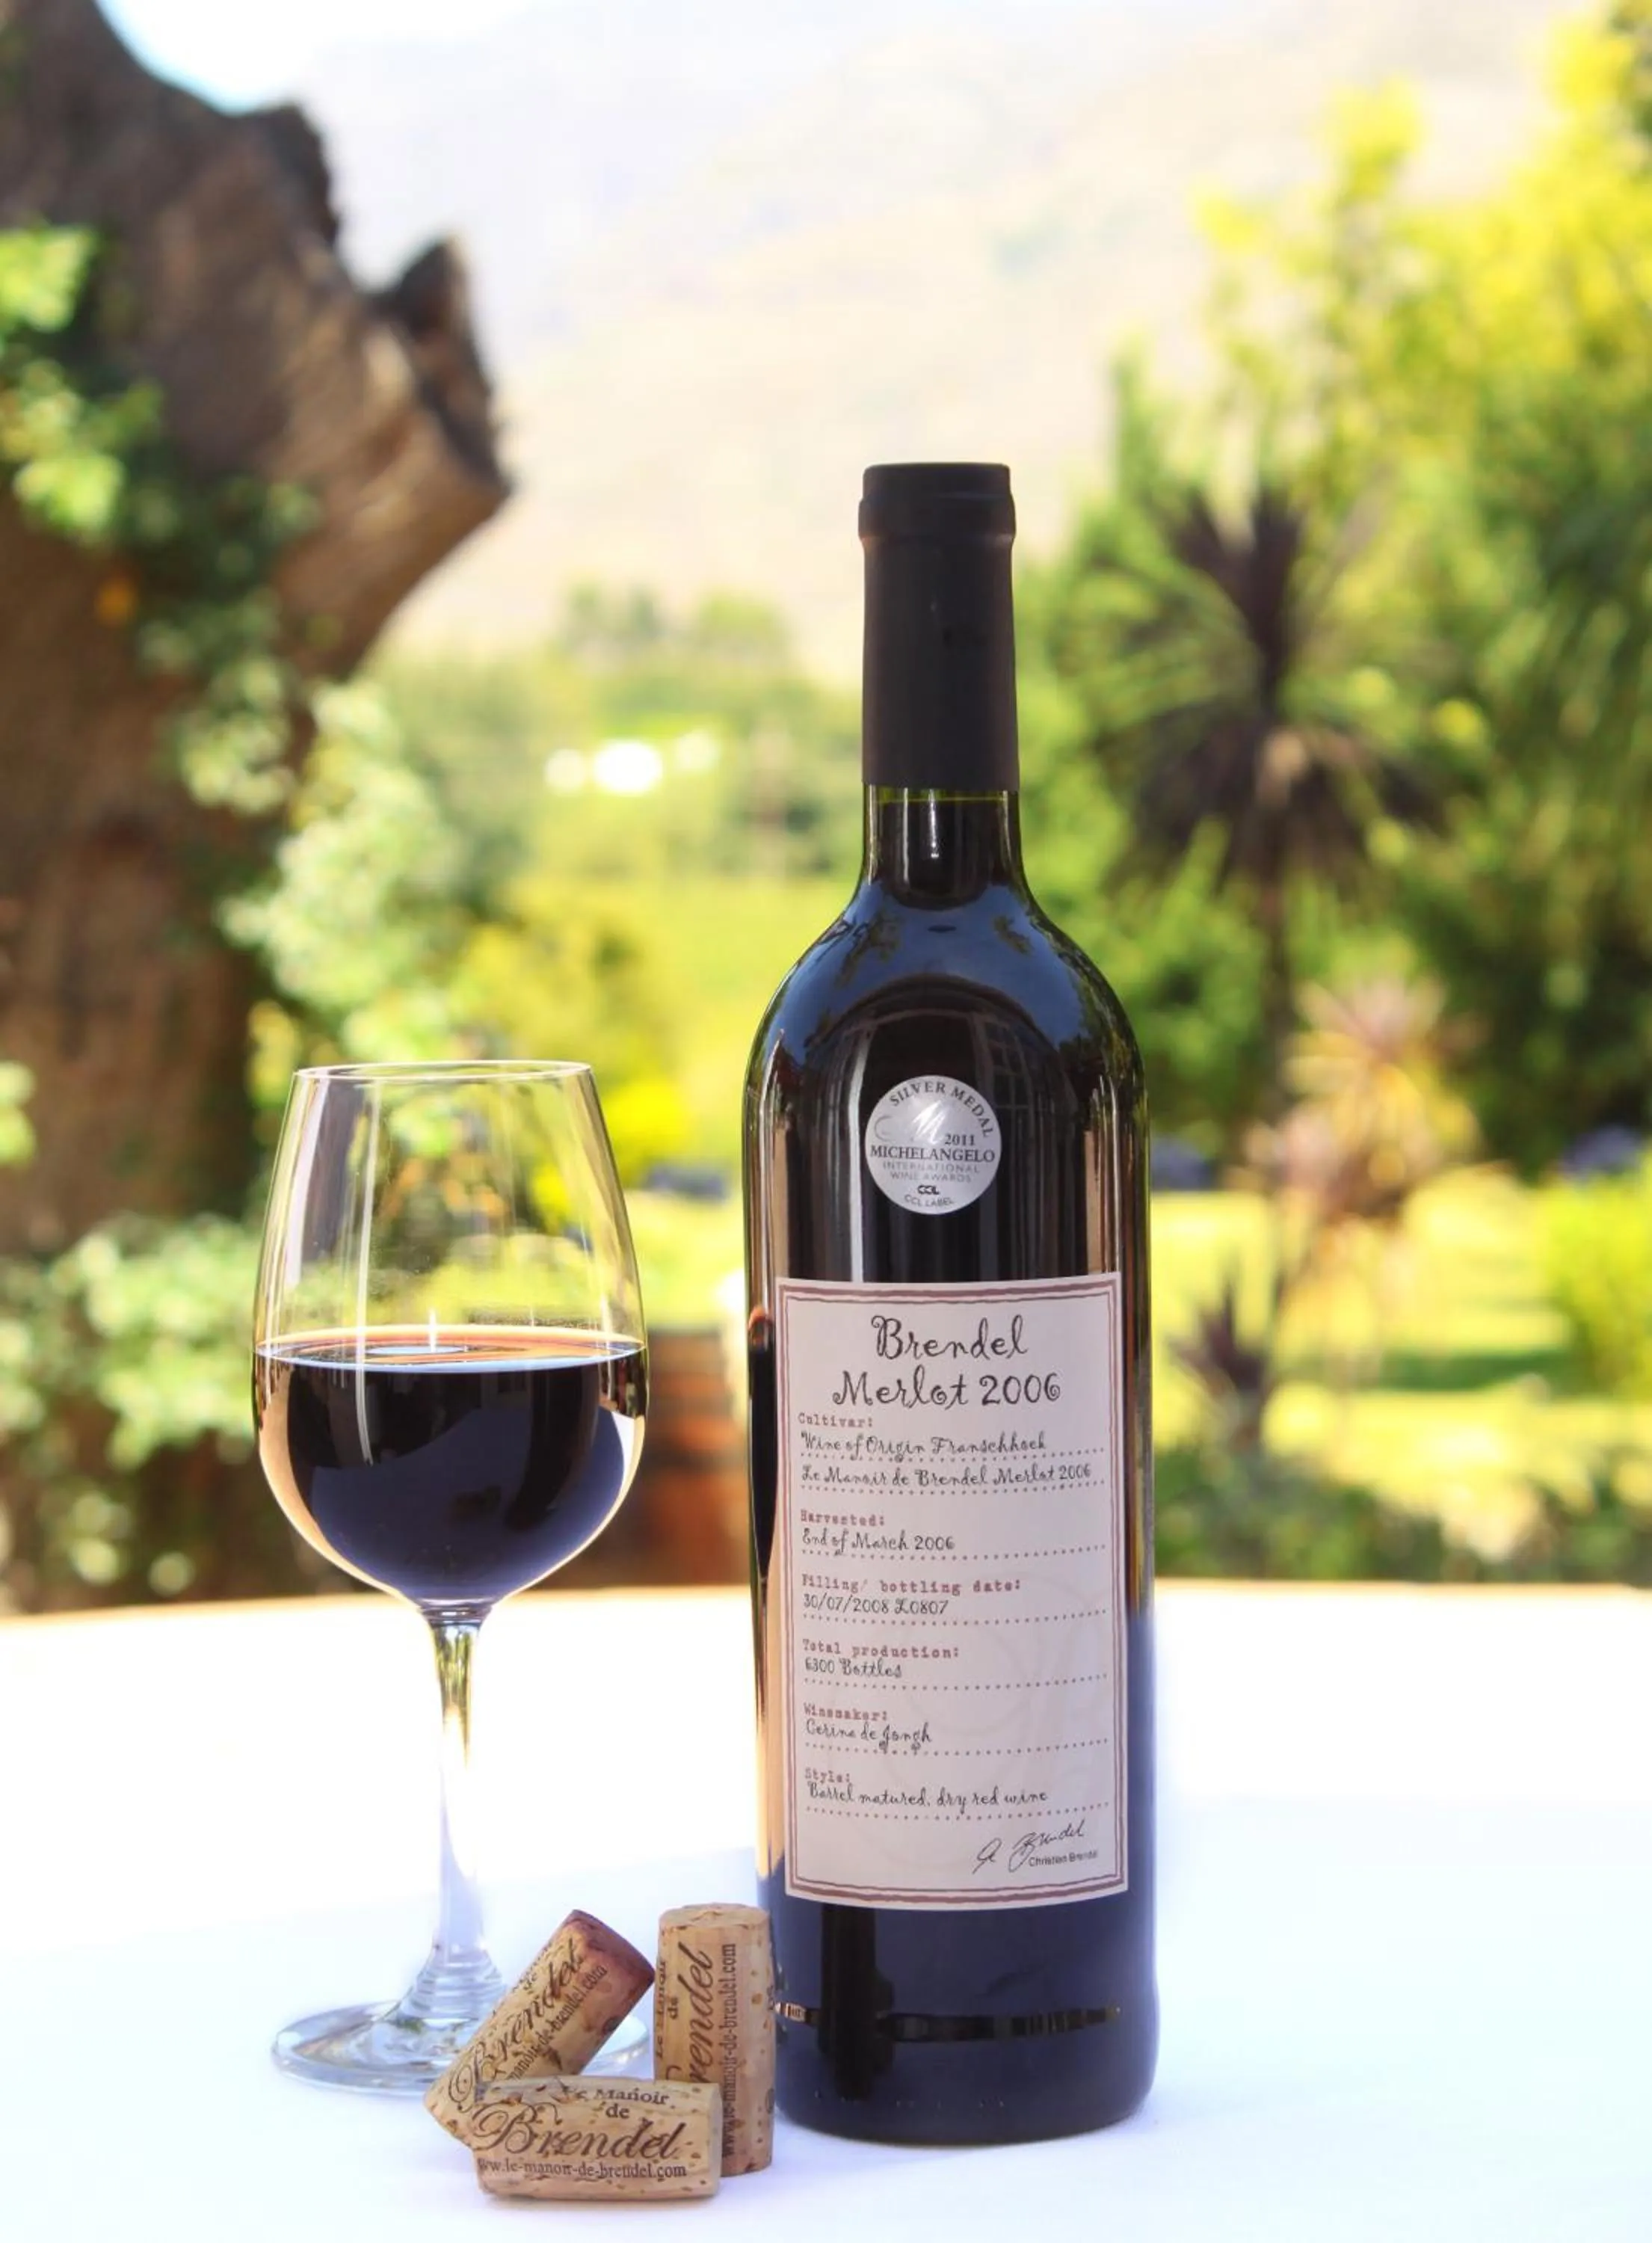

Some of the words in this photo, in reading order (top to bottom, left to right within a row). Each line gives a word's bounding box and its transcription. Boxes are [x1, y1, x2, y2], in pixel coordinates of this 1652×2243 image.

[890, 1081, 946, 1107] SILVER
[951, 1086, 993, 1139] MEDAL
[944, 1133, 976, 1145] 2011
[869, 1145, 996, 1163] MICHELANGELO
[882, 1160, 981, 1174] INTERNATIONAL
[890, 1171, 919, 1181] WINE
[922, 1173, 973, 1183] AWARDS
[904, 1194, 922, 1207] CCL
[925, 1197, 955, 1207] LABEL
[871, 1314, 1029, 1360] Brendel
[832, 1364, 970, 1409] Merlot
[978, 1372, 1062, 1406] 2006
[798, 1412, 874, 1427] Cultivar:
[801, 1430, 842, 1450] Wine
[845, 1433, 864, 1461] of
[866, 1435, 926, 1463] Origin
[801, 1463, 821, 1481] Le
[823, 1465, 887, 1486] Manoir
[892, 1466, 910, 1486] de
[913, 1464, 987, 1487] Brendel
[992, 1462, 1055, 1485] Merlot
[1058, 1462, 1091, 1480] 2006
[801, 1509, 885, 1526] Harvested:
[801, 1527, 827, 1545] End
[830, 1527, 850, 1556] of
[851, 1530, 910, 1551] March
[913, 1535, 956, 1551] 2006
[880, 1579, 962, 1596] bottling
[972, 1578, 1021, 1593] date:
[803, 1592, 890, 1614] 30/07/2008
[803, 1638, 842, 1655] Total
[851, 1644, 960, 1658] production:
[805, 1658, 835, 1674] 6300
[839, 1657, 902, 1679] Bottles
[804, 1702, 888, 1720] Winemaker:
[860, 1721, 878, 1741] de
[805, 1767, 851, 1783] Style:
[807, 1781, 854, 1802] Barrel
[860, 1786, 931, 1807] matured,
[936, 1787, 967, 1815] dry
[971, 1785, 999, 1806] red
[1003, 1788, 1048, 1805] wine
[665, 1941, 715, 2083] rendel
[668, 1996, 679, 2020] de
[605, 2102, 630, 2119] de
[471, 2101, 686, 2161] Brendel
